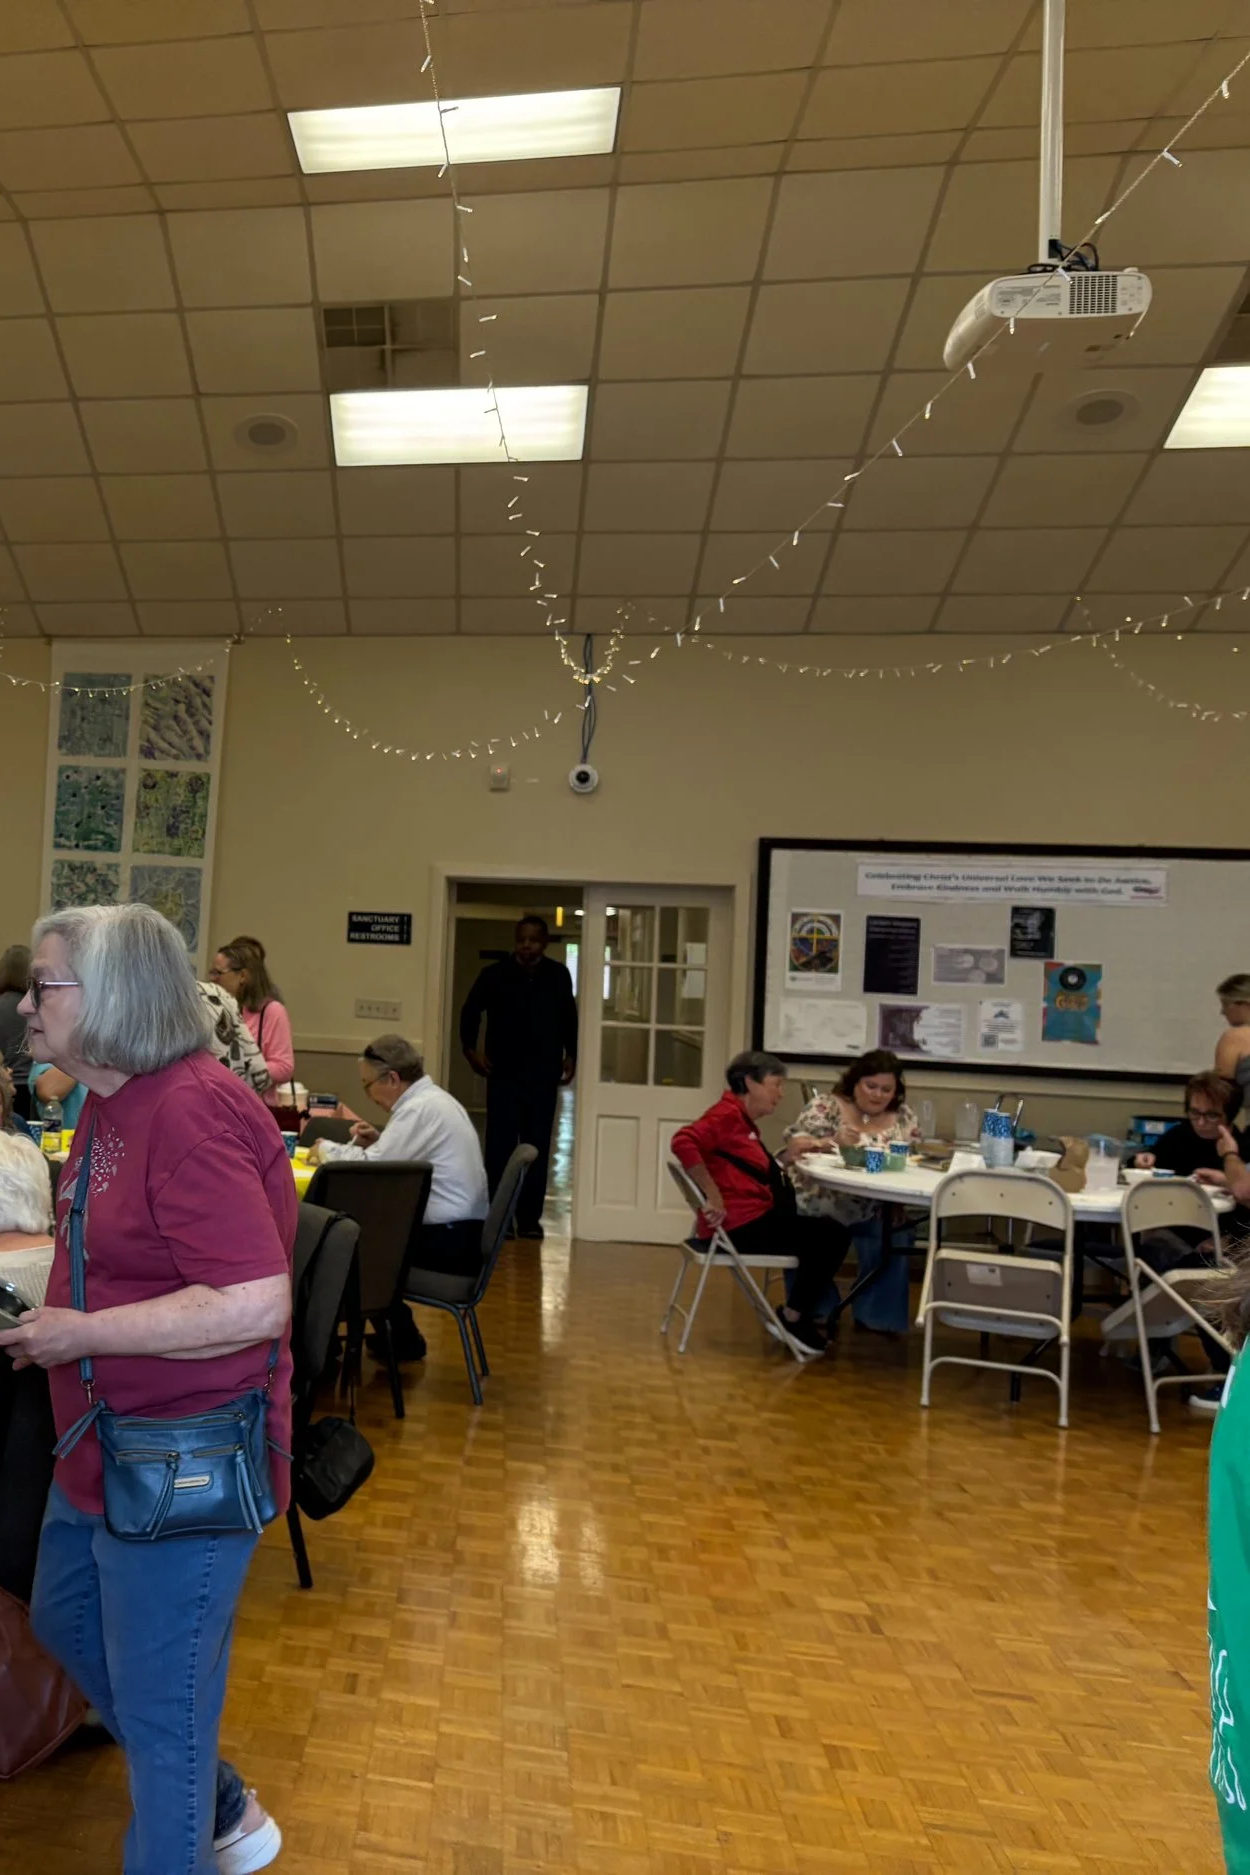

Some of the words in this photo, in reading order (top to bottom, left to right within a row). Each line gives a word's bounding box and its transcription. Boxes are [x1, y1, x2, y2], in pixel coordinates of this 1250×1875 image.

[865, 872, 921, 882] Celebrating
[923, 872, 959, 881] Christ's
[961, 873, 1008, 882] Universal
[1011, 874, 1035, 882] Love
[1057, 875, 1081, 883] Seek
[891, 883, 934, 891] Embrace
[936, 883, 979, 892] Kindness
[1004, 885, 1030, 893] Walk
[1032, 886, 1072, 894] Humbly
[1074, 886, 1098, 894] with
[352, 915, 399, 923] SANCTUARY
[370, 924, 400, 932] OFFICE
[350, 932, 399, 941] RESTROOMS
